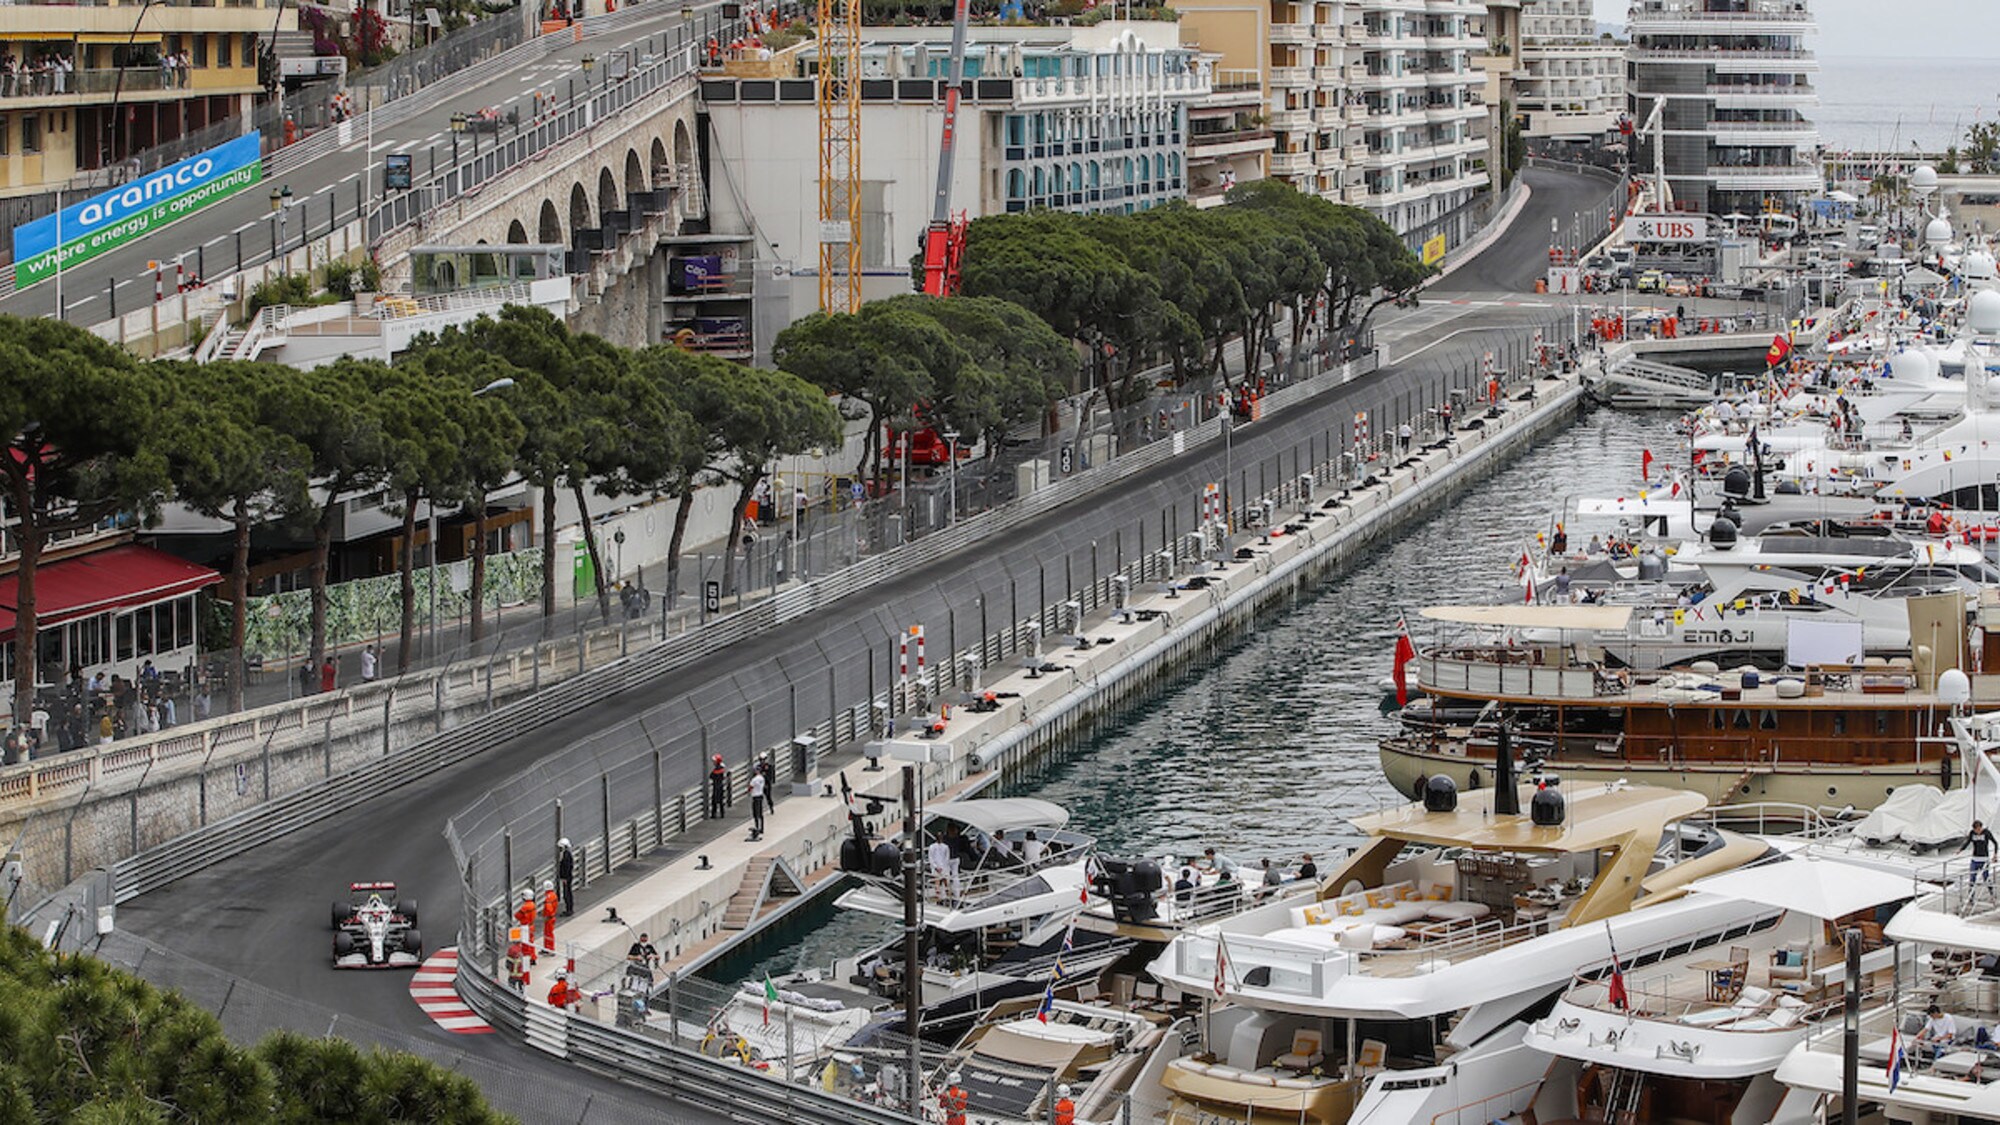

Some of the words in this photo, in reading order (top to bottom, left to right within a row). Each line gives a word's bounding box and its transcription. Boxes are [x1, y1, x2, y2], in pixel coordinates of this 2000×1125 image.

[79, 157, 213, 226] aramco
[28, 241, 86, 274] where
[91, 213, 149, 247] energy
[152, 206, 166, 220] is
[1656, 222, 1695, 239] UBS
[708, 584, 718, 610] 50
